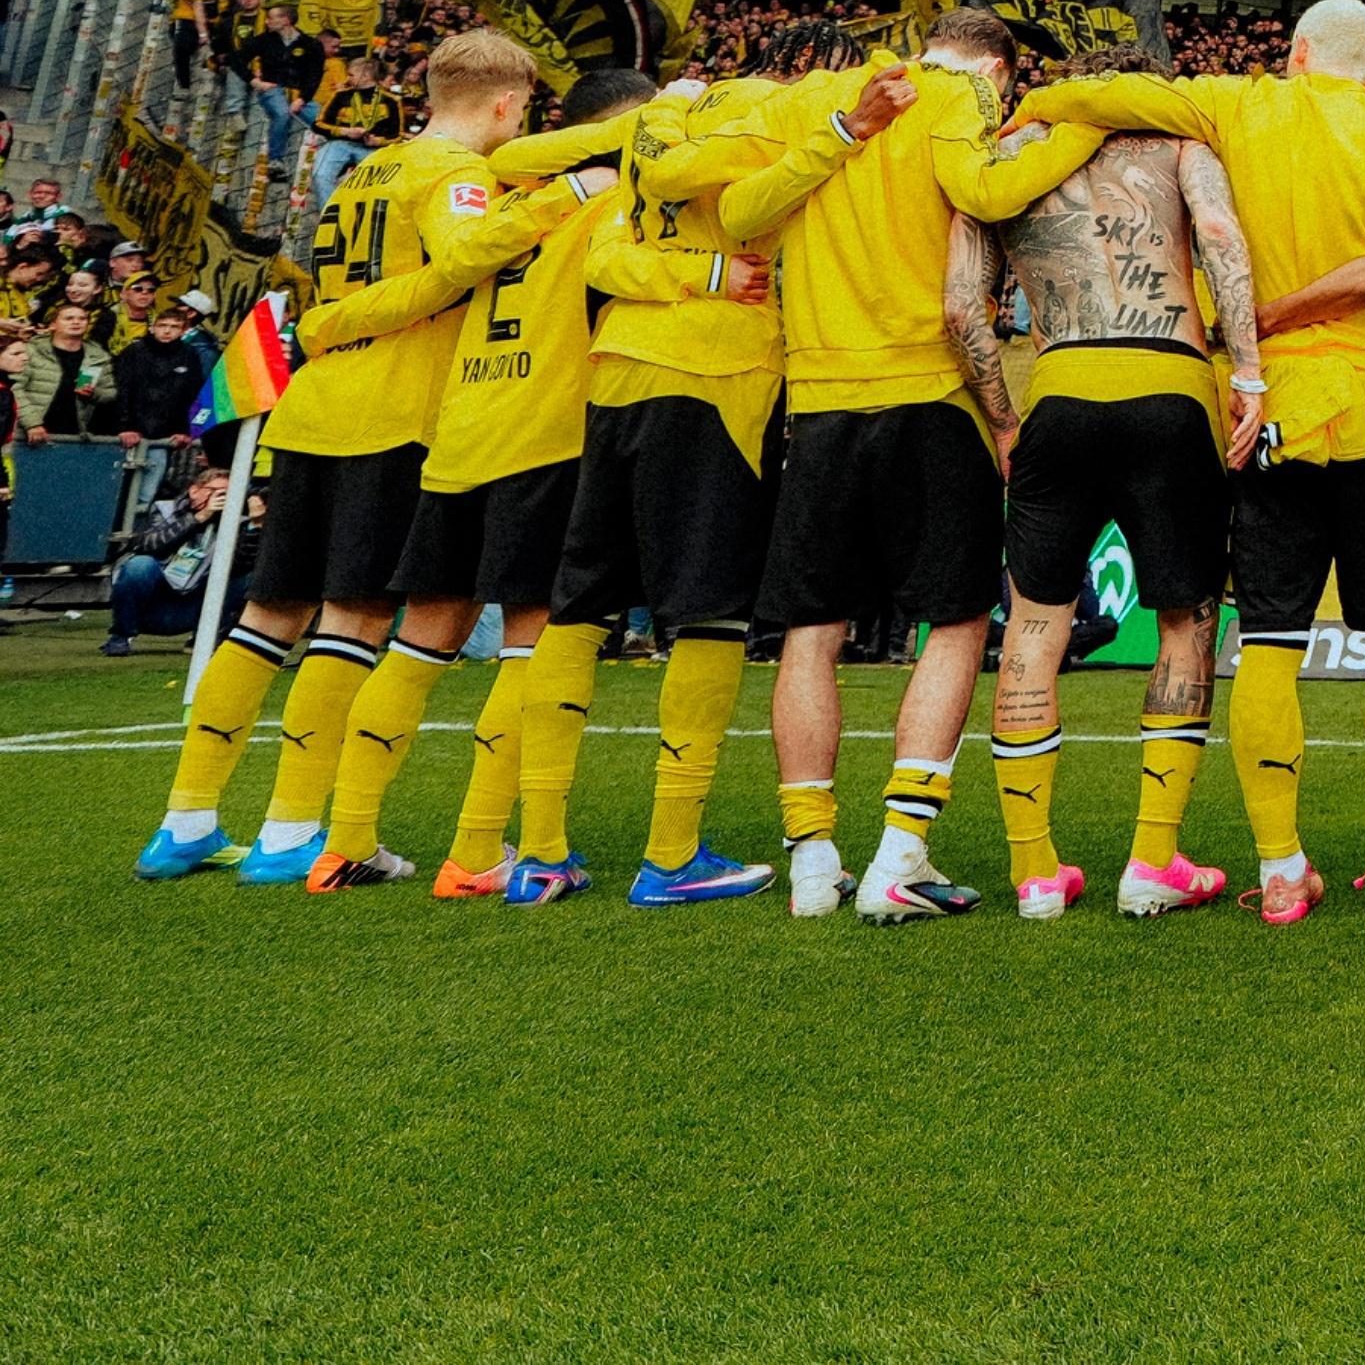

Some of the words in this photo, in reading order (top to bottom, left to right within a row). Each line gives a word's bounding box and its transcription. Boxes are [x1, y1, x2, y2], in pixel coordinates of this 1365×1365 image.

[1093, 215, 1143, 247] SKY
[1115, 253, 1167, 300] THE
[1109, 304, 1187, 338] LIMIT
[1022, 620, 1049, 634] 777
